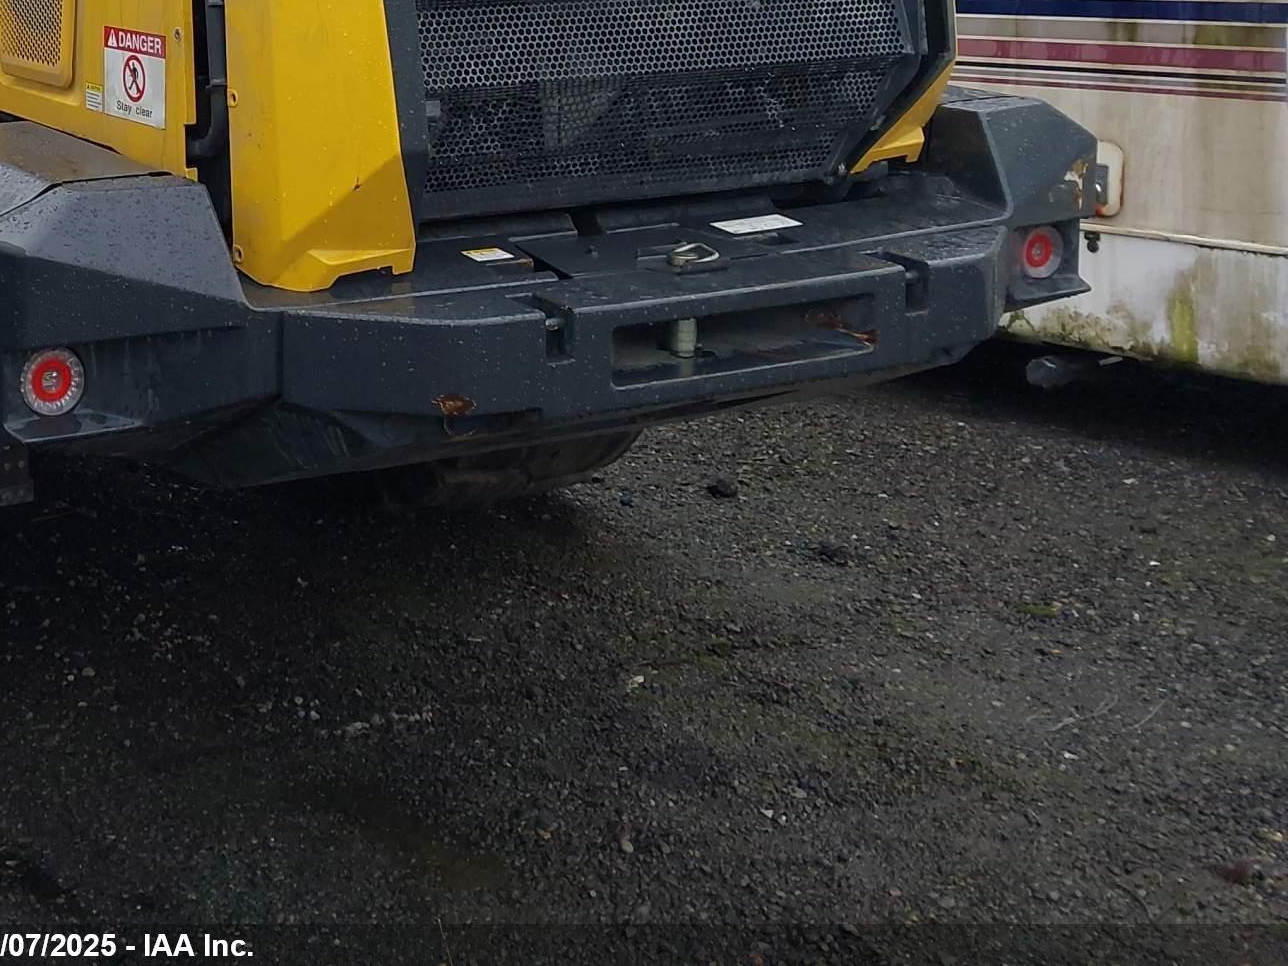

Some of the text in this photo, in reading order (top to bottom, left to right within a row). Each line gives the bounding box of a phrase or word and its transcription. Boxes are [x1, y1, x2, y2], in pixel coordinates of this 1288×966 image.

[118, 31, 162, 54] DANGER
[116, 100, 153, 118] Stay clear
